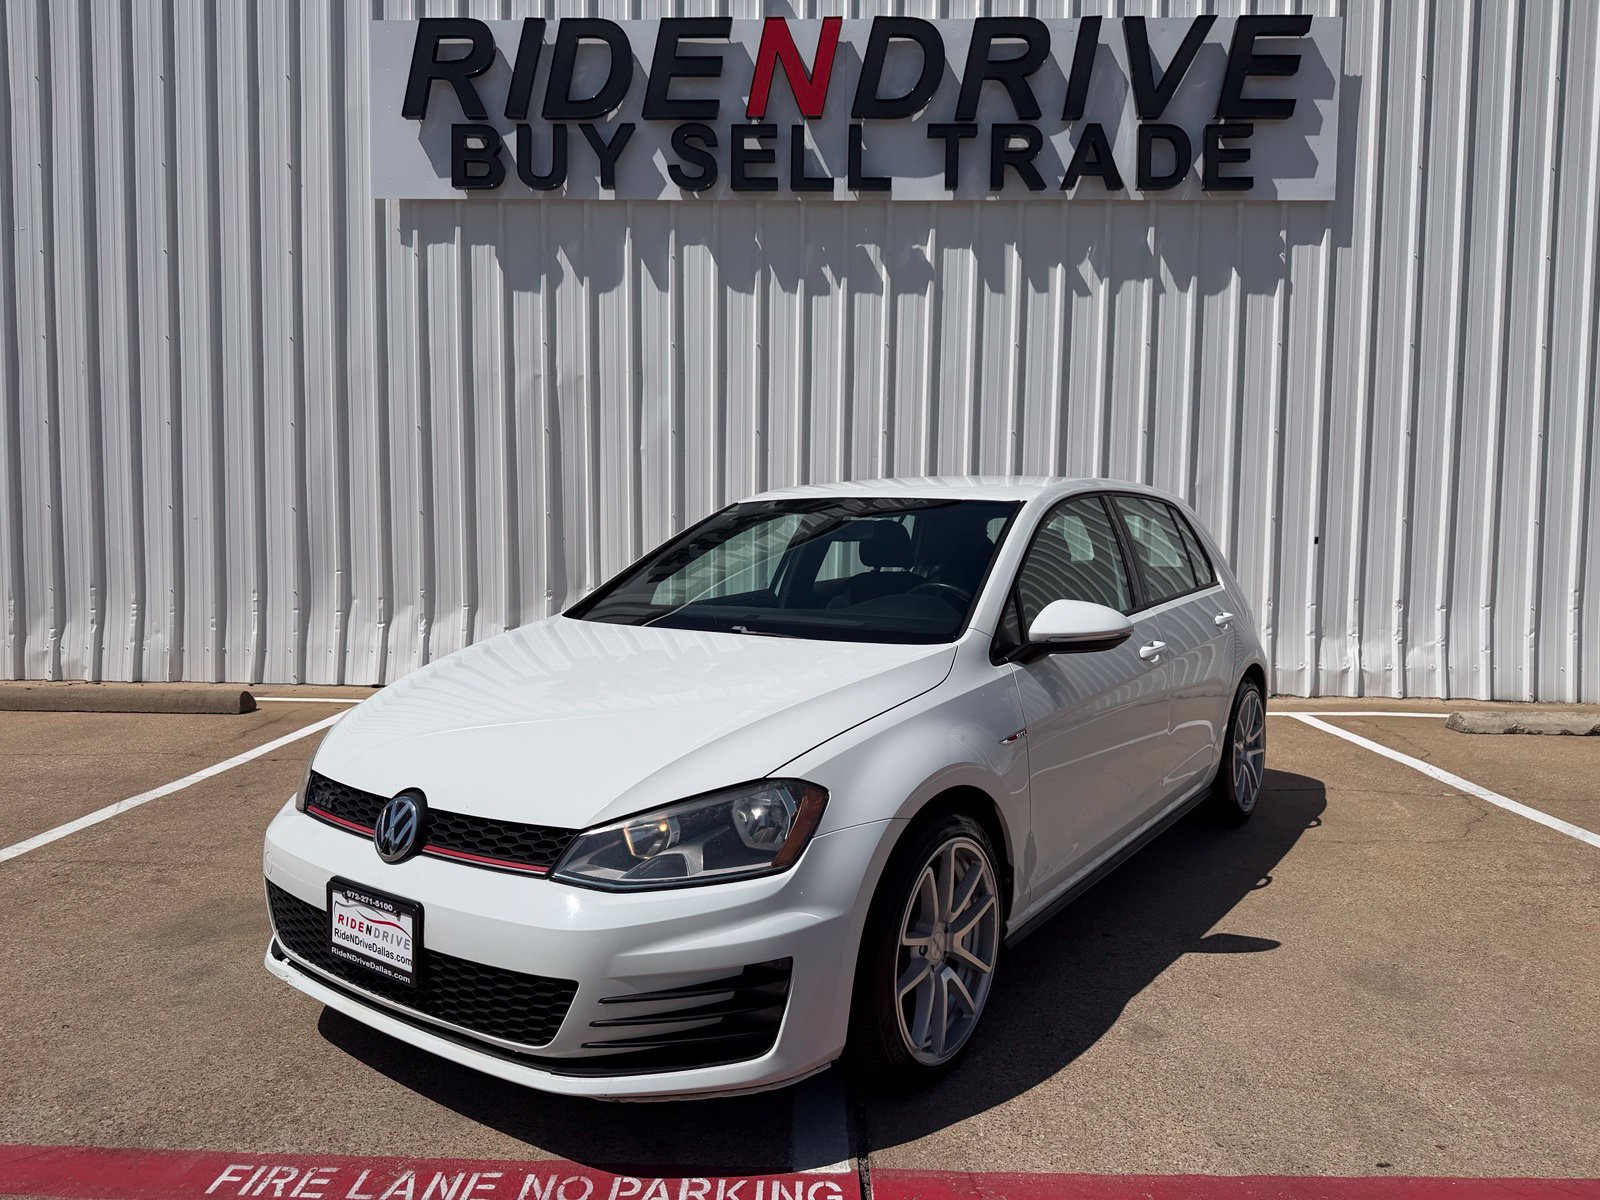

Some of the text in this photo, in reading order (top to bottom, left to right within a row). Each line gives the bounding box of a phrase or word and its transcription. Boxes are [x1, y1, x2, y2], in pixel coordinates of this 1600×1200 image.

[451, 123, 1254, 192] BUY SELL TRADE
[346, 890, 393, 911] 972-271-5100
[333, 927, 413, 967] RideNDriveDallas.com
[337, 913, 411, 951] RIDENDRIVE
[331, 946, 411, 984] RideNDriveDallas.com
[204, 1164, 844, 1200] FIRE LANE NO PARKING
